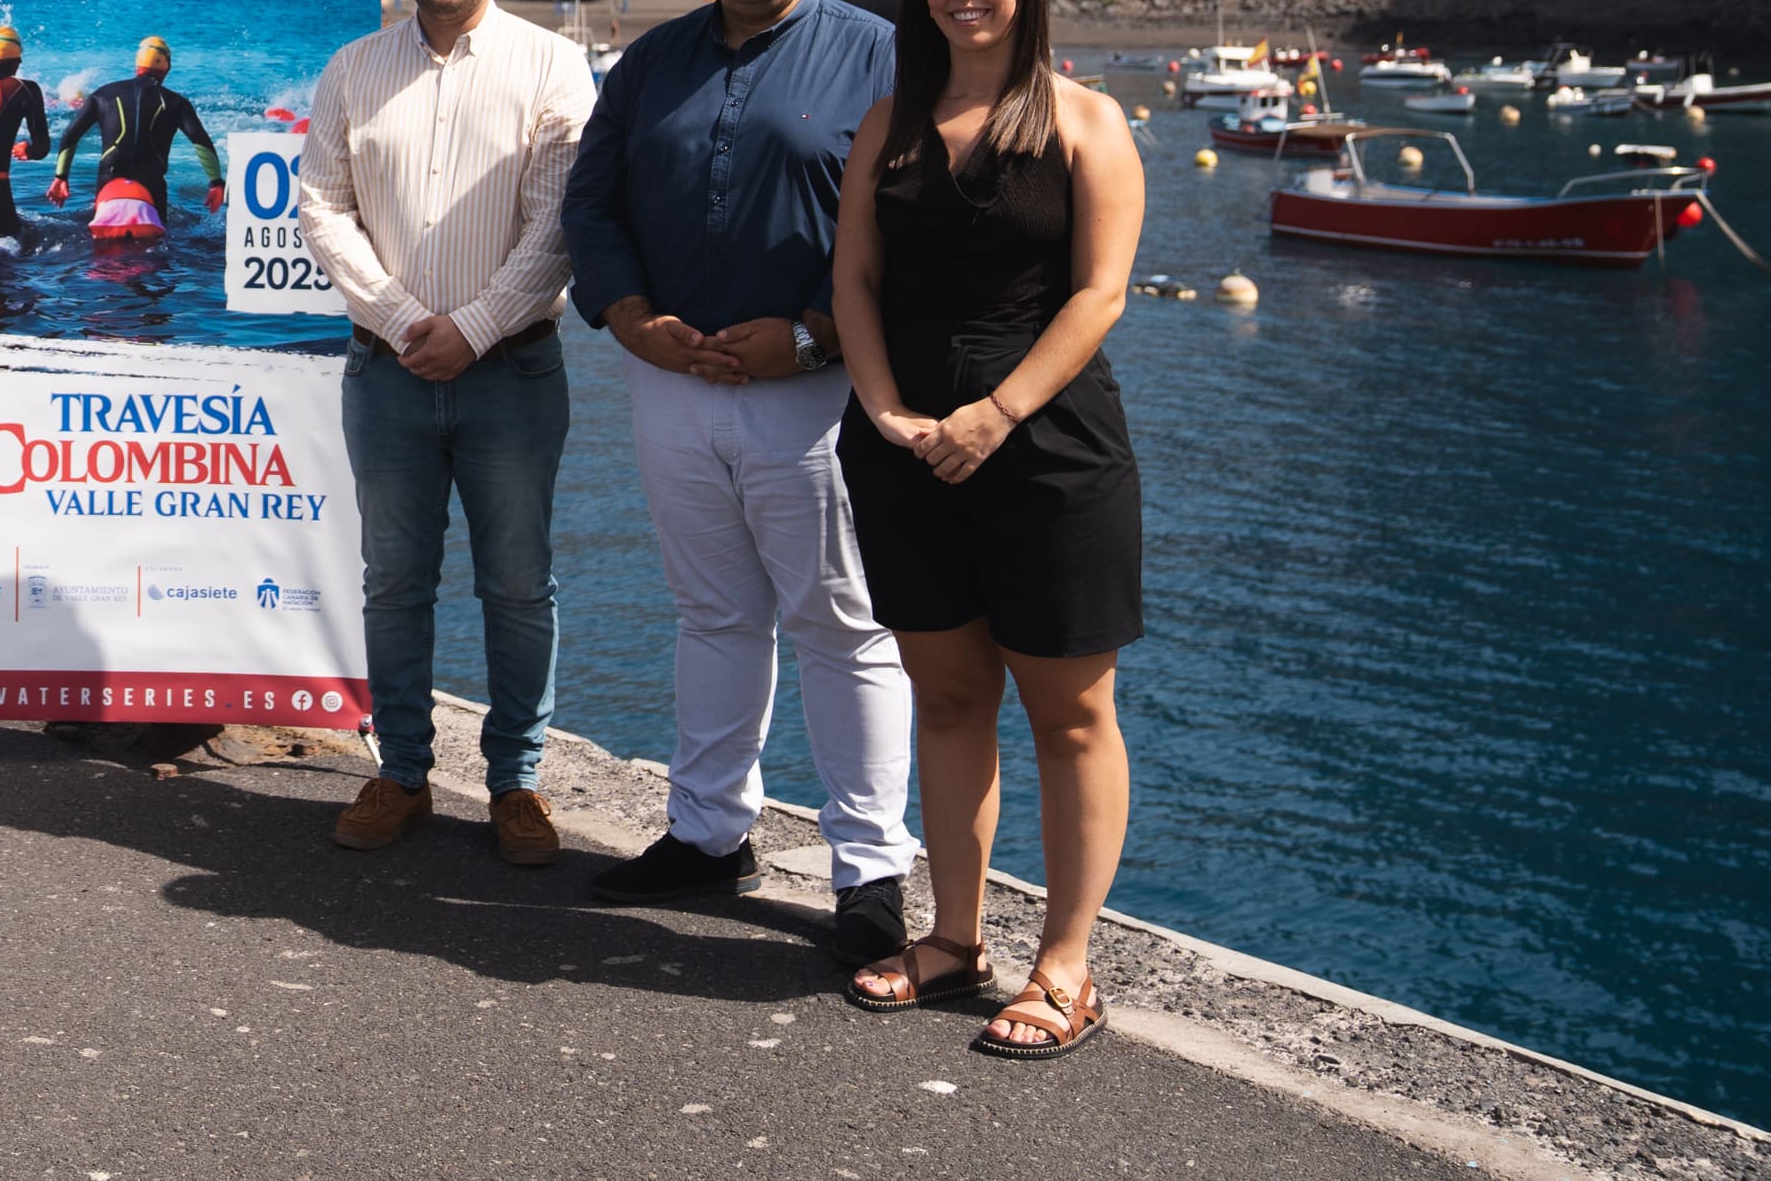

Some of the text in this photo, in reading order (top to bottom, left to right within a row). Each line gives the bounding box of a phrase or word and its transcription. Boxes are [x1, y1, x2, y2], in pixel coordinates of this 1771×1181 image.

[51, 384, 277, 436] TRAVESÍA
[46, 489, 327, 522] VALLE GRAN REY
[52, 586, 128, 595] AYUNTAMIENTO
[167, 586, 238, 601] cajasiete
